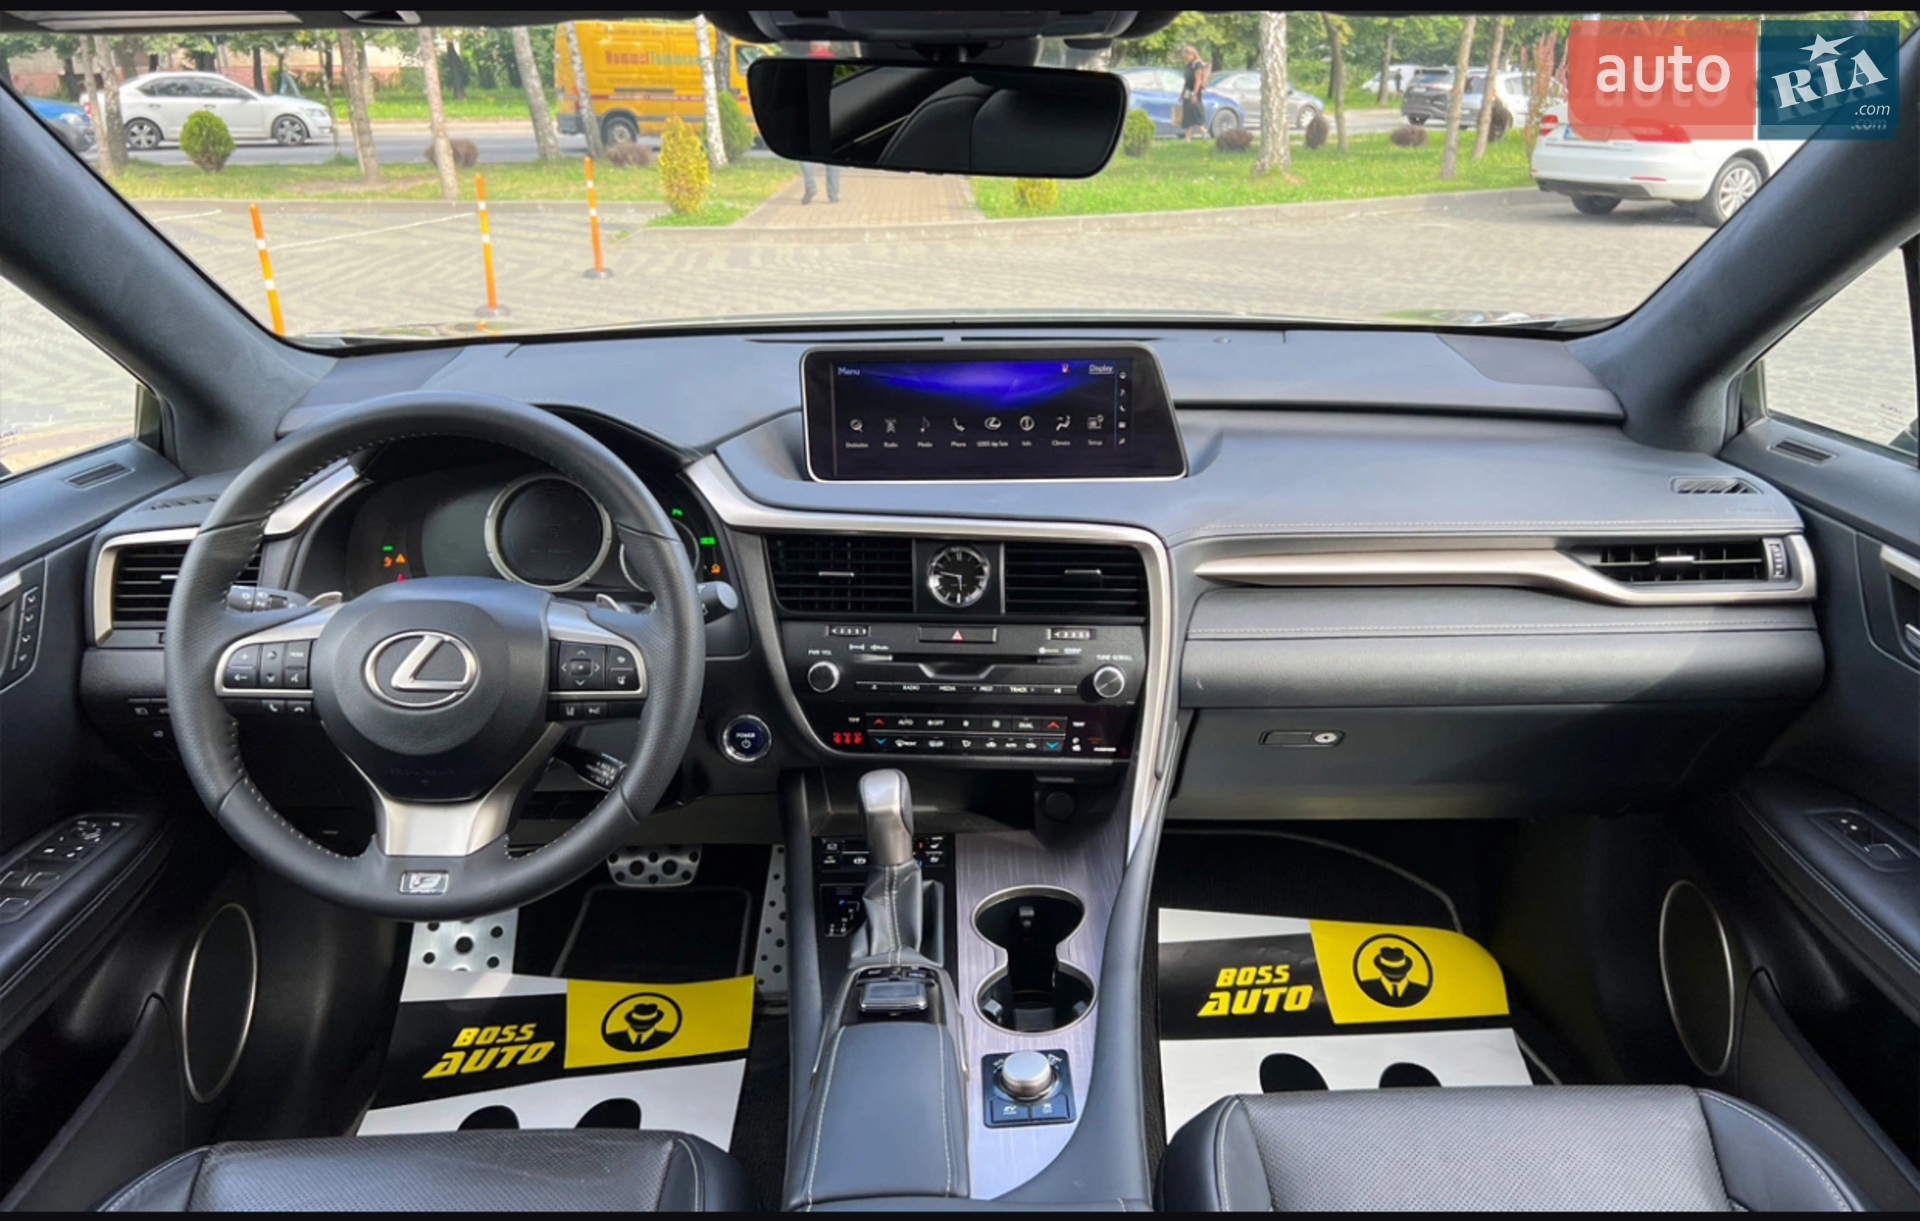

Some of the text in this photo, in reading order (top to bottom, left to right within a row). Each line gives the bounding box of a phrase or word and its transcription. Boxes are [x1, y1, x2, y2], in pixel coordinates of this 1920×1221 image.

[837, 367, 860, 375] Menu
[1088, 364, 1113, 373] Display
[1215, 965, 1290, 988] BOSS
[1197, 985, 1313, 1017] AUTO
[452, 1023, 537, 1047] BOSS
[422, 1041, 555, 1079] AUTO
